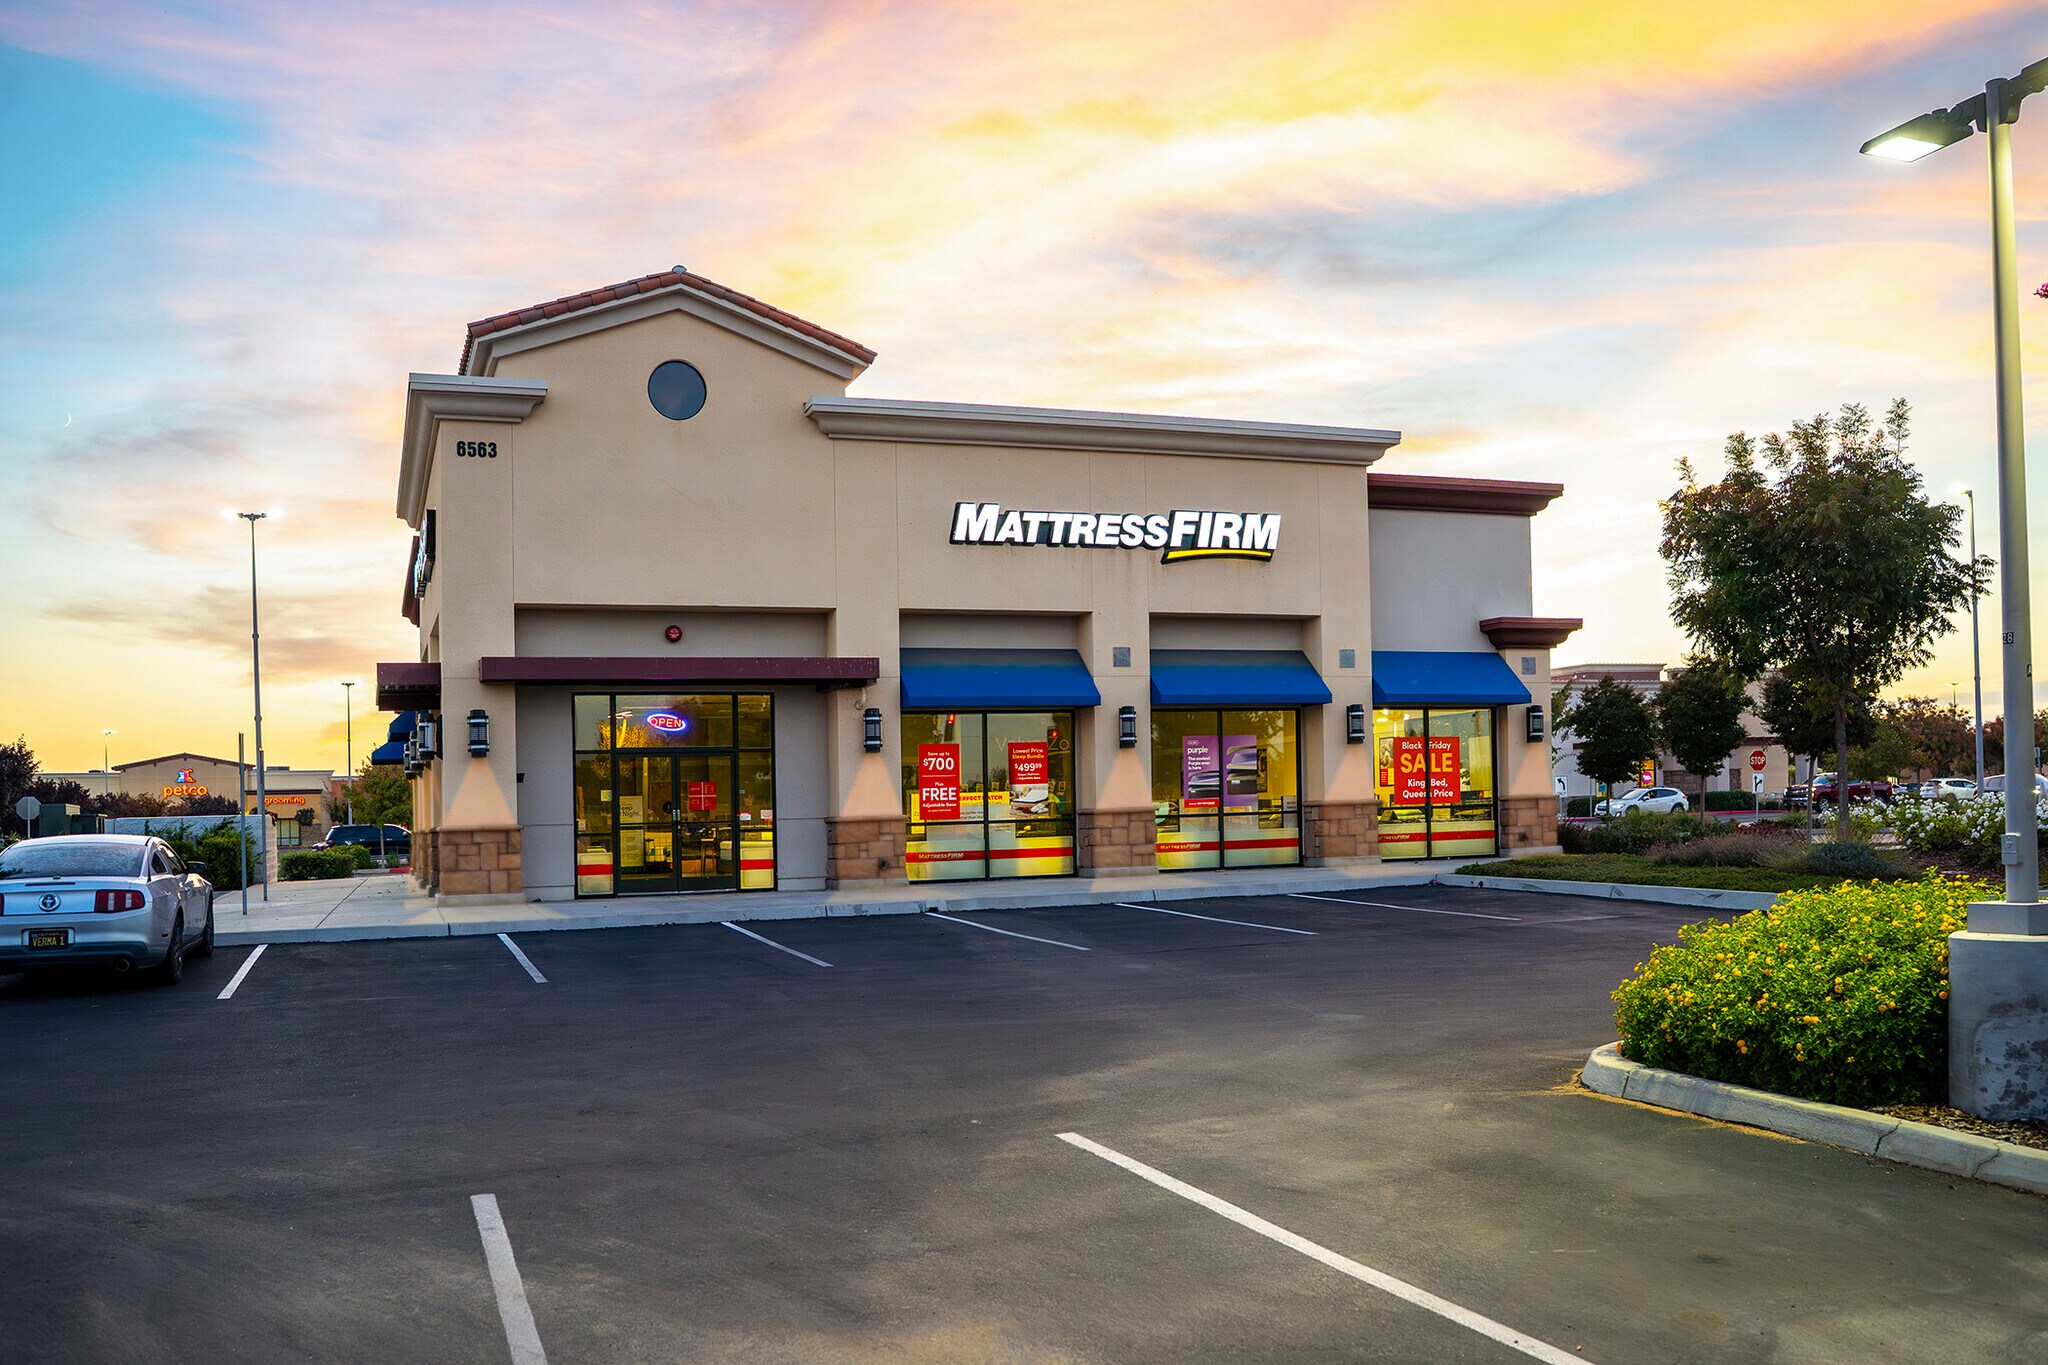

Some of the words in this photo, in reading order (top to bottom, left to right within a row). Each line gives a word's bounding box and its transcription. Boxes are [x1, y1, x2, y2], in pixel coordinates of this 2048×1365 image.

[456, 440, 498, 458] 6563
[650, 717, 681, 728] OPEN
[1187, 746, 1209, 755] purple
[1401, 741, 1423, 750] Black
[1429, 741, 1452, 752] Friday
[923, 757, 955, 771] $700
[1400, 752, 1453, 773] SALE
[1750, 756, 1766, 765] STOP
[1407, 778, 1426, 789] King
[1430, 777, 1448, 788] Bed,
[163, 784, 209, 799] petco
[922, 787, 957, 801] FREE
[1433, 789, 1454, 798] Price
[264, 796, 306, 806] grooming
[32, 936, 57, 947] VERMA
[59, 936, 65, 946] 1
